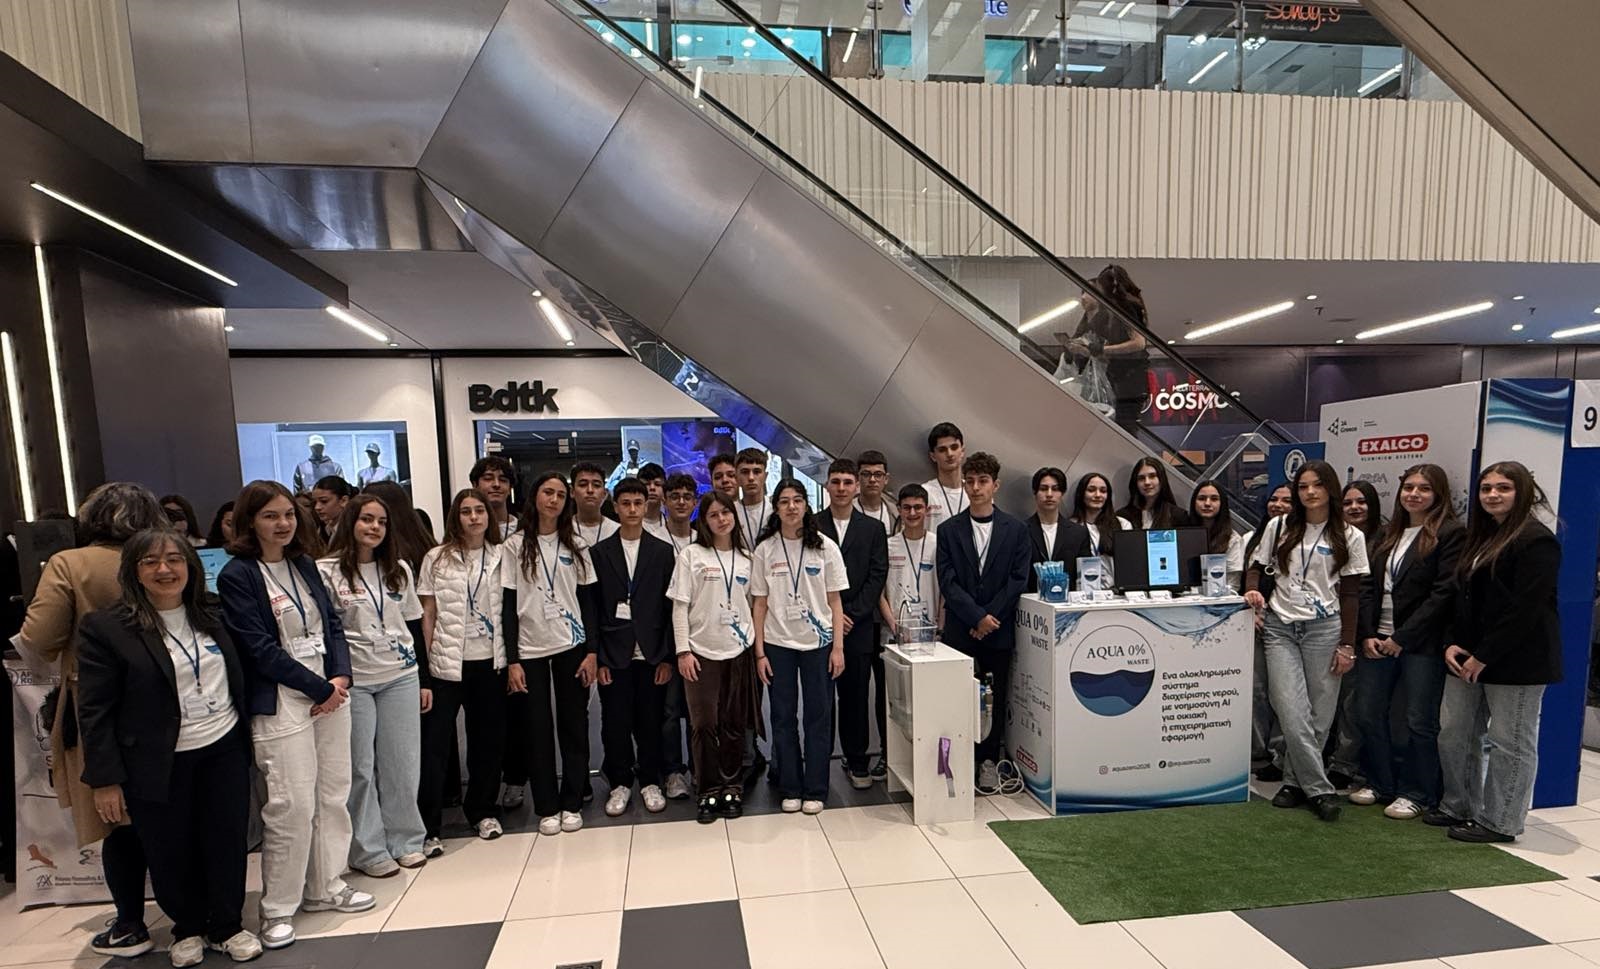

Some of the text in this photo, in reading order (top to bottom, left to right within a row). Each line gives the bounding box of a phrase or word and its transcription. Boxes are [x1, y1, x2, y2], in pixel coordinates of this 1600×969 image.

[468, 380, 559, 413] Bdtk
[1584, 406, 1597, 431] 9
[1361, 437, 1424, 452] EXALCO
[1015, 608, 1048, 635] QUA 0%
[1031, 635, 1048, 651] WASTE
[1086, 644, 1146, 660] AQUA 0%
[1127, 658, 1150, 666] WASTE
[1179, 668, 1241, 678] ολοκληρωμένο
[1162, 681, 1199, 690] σύστημα
[1162, 691, 1210, 701] διαχείρισης
[1162, 705, 1172, 713] με
[1174, 701, 1220, 710] νοημοσύνη
[1162, 711, 1207, 723] για οικιακή
[1169, 720, 1231, 731] επιχειρηματική
[1162, 732, 1204, 742] εφαρμογή
